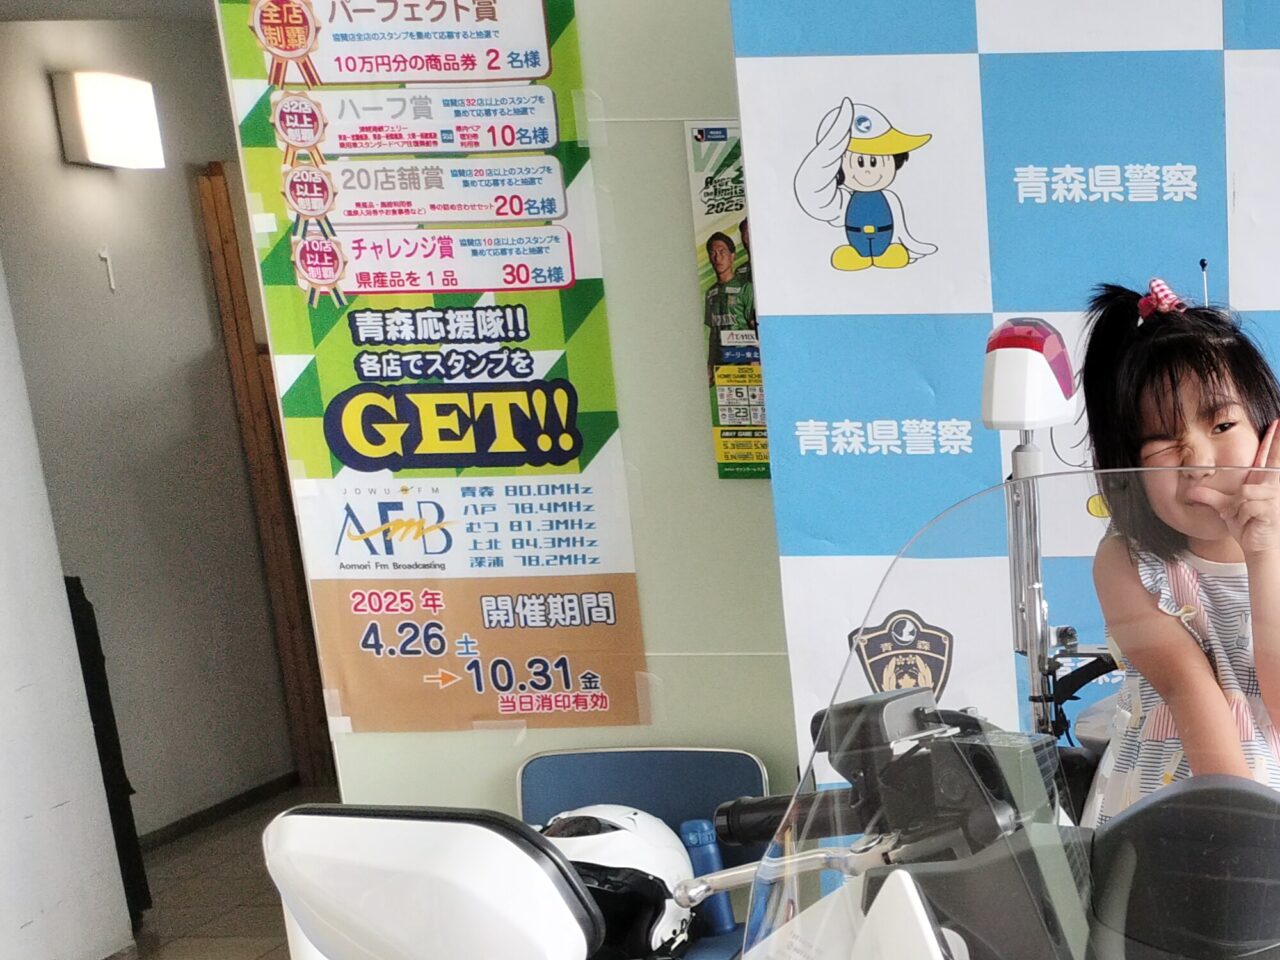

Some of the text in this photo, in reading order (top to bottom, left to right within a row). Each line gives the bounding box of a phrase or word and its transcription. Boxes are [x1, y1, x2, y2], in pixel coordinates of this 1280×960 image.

[261, 2, 306, 25] 全店
[334, 48, 541, 73] 10万円分の商品券 2 名様
[337, 95, 433, 120] ハーフ賞
[286, 113, 314, 128] 以上
[487, 124, 549, 148] 10名様
[292, 170, 322, 183] 20店
[341, 165, 444, 191] 20店舗賞
[1013, 162, 1199, 205] 青森県警察
[296, 184, 323, 198] 以上
[493, 194, 558, 217] 20名様
[704, 201, 745, 215] 2025
[304, 240, 332, 253] 10店
[351, 235, 454, 261] チャレンジ賞
[306, 253, 334, 267] 以上
[502, 263, 565, 286] 30名様
[354, 304, 528, 343] 青森応援隊!!
[359, 351, 533, 378] 各店でスタンプを
[341, 387, 574, 459] GET!!
[794, 416, 974, 457] 青森県警察
[460, 483, 593, 498] 青森 80.0MHz
[463, 501, 595, 516] 八戸 78.4MHz
[465, 519, 597, 533] むつ 81.3MHz
[468, 537, 599, 550] 上北 84.3MHz
[339, 560, 446, 571] Aomori Fm Broadcasting
[469, 553, 600, 568] 深浦 78.2MHz
[350, 590, 444, 614] 2025 年
[480, 591, 616, 629] 開催期間
[360, 621, 478, 656] 4.26 土
[465, 656, 601, 693] 10.31 金
[499, 692, 608, 714] 当日消印有効
